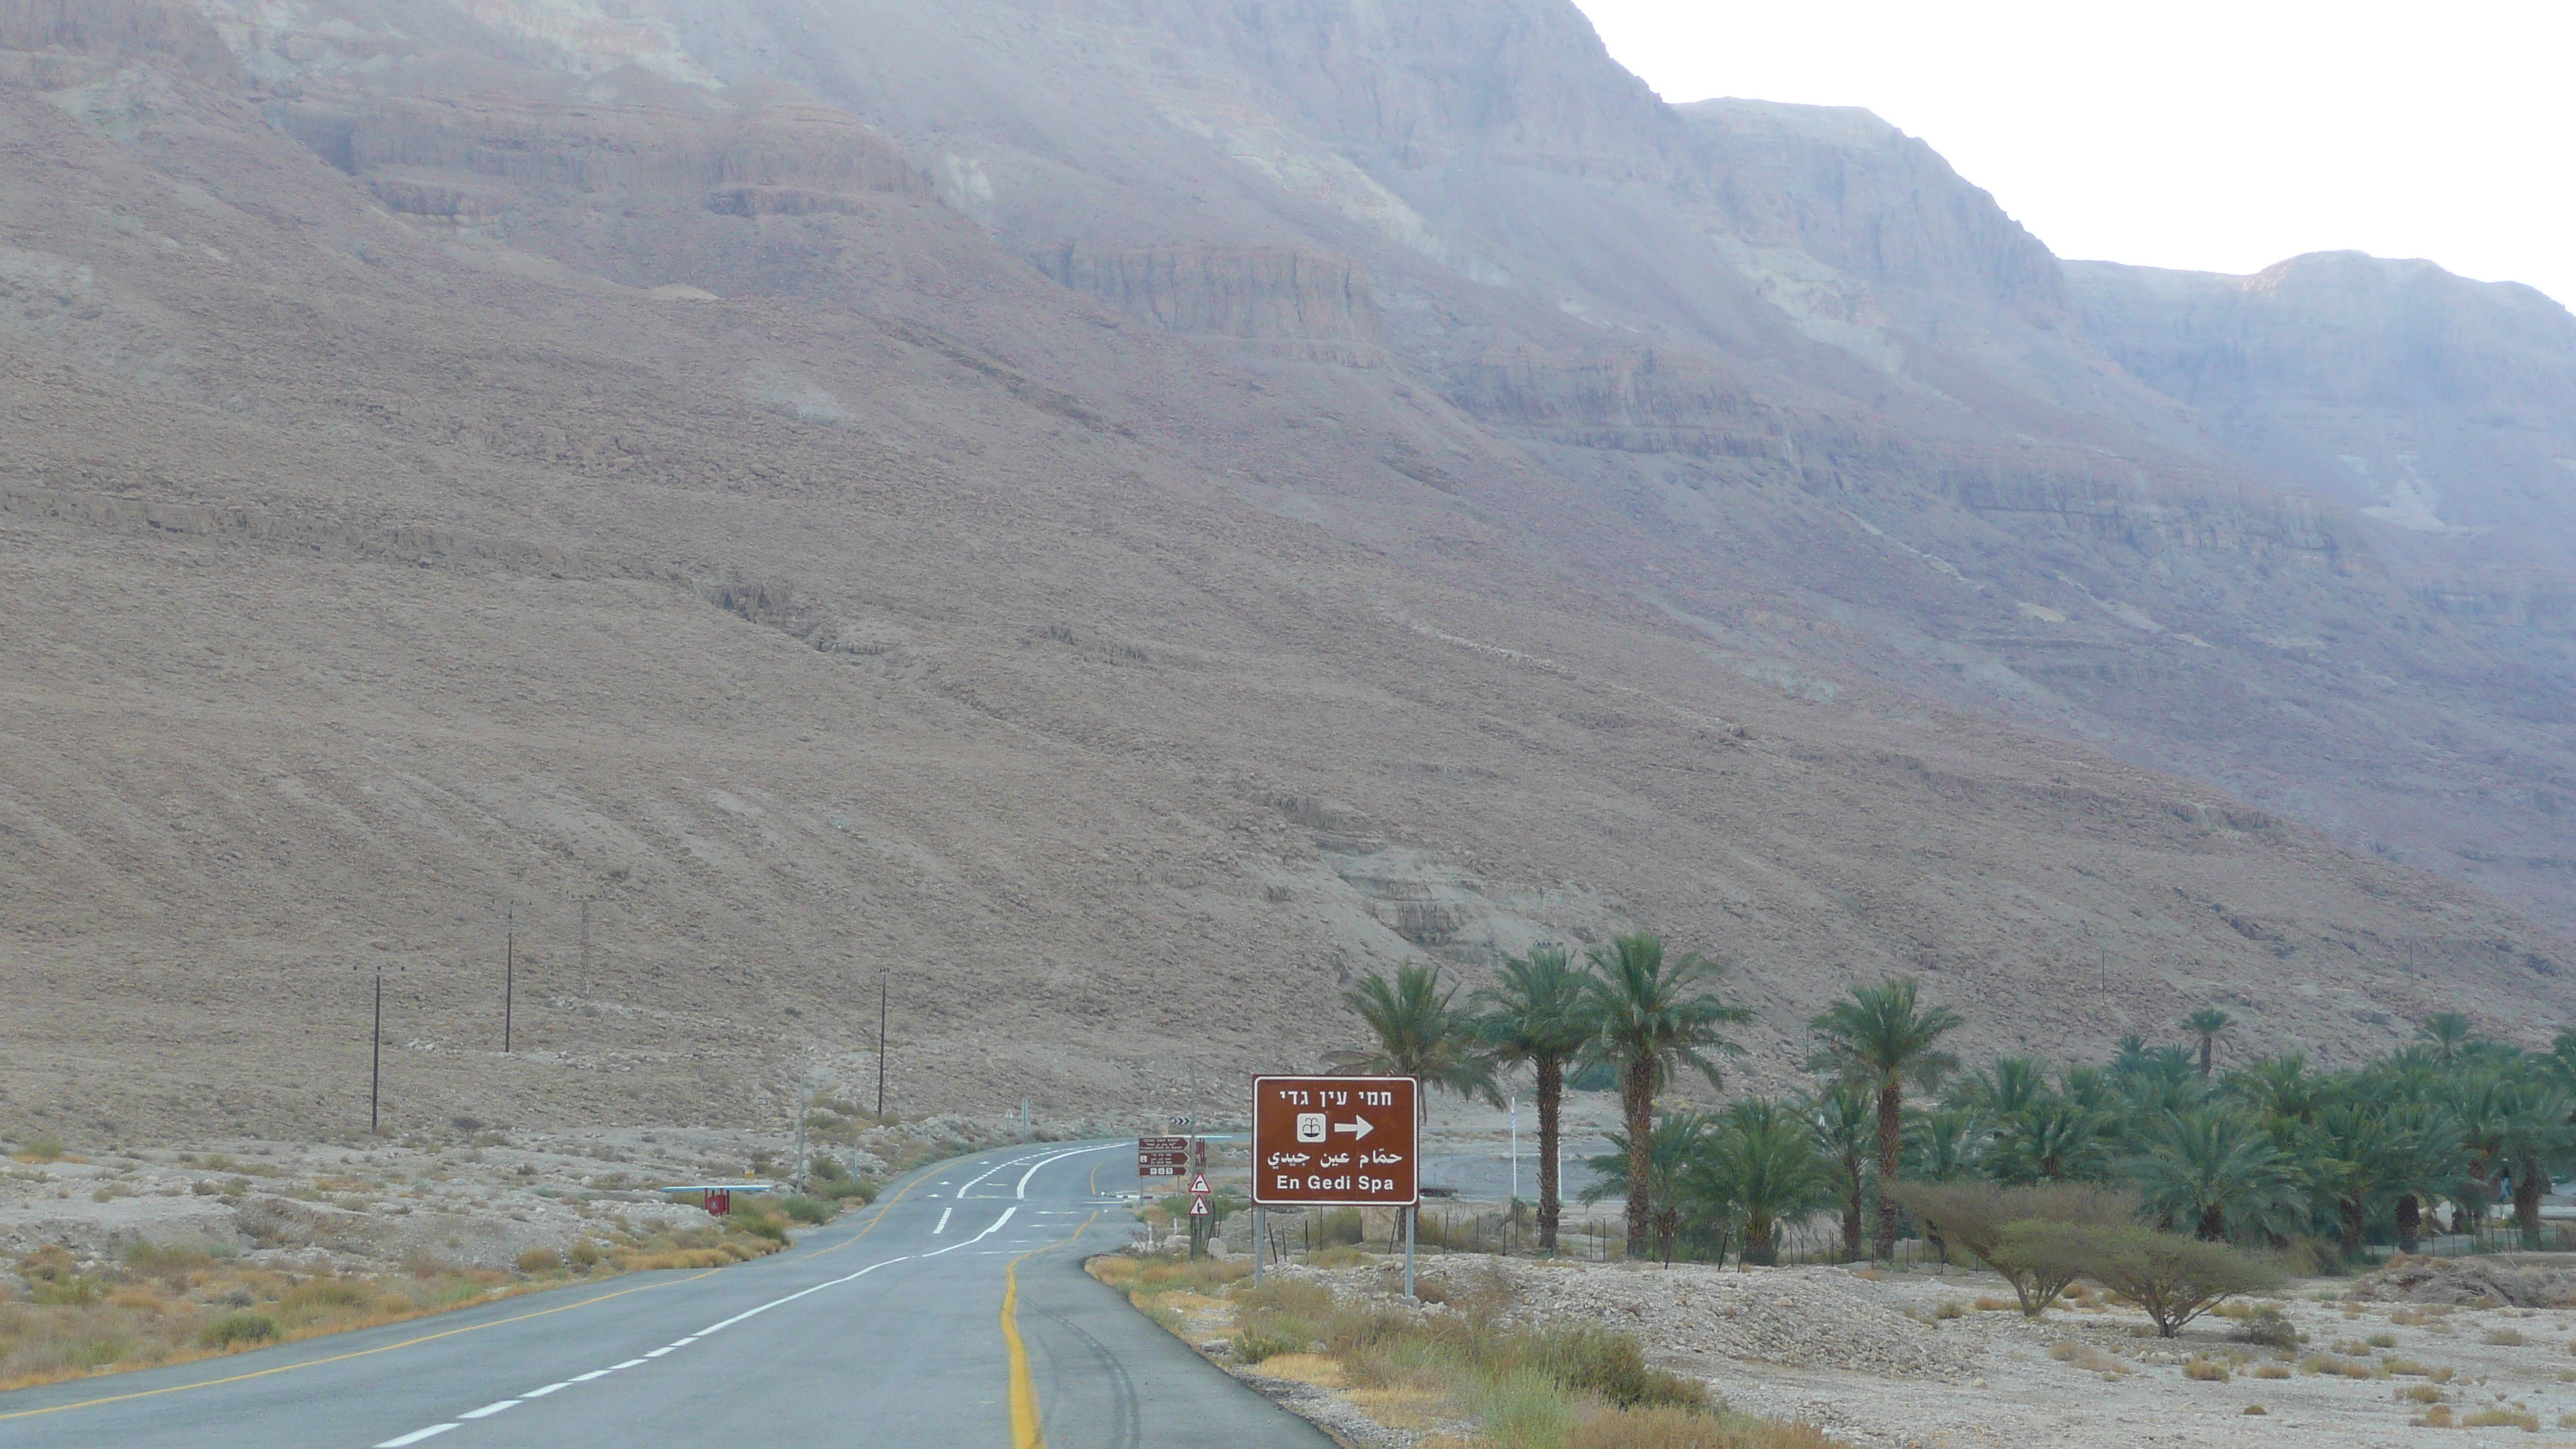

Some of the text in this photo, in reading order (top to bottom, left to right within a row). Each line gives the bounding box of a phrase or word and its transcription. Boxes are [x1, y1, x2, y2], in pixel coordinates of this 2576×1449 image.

[1279, 1091, 1392, 1108] חמי עין גדי
[1267, 1152, 1311, 1170] جيدي
[1320, 1152, 1351, 1167] عين
[1276, 1175, 1394, 1193] En Gedi Spa
